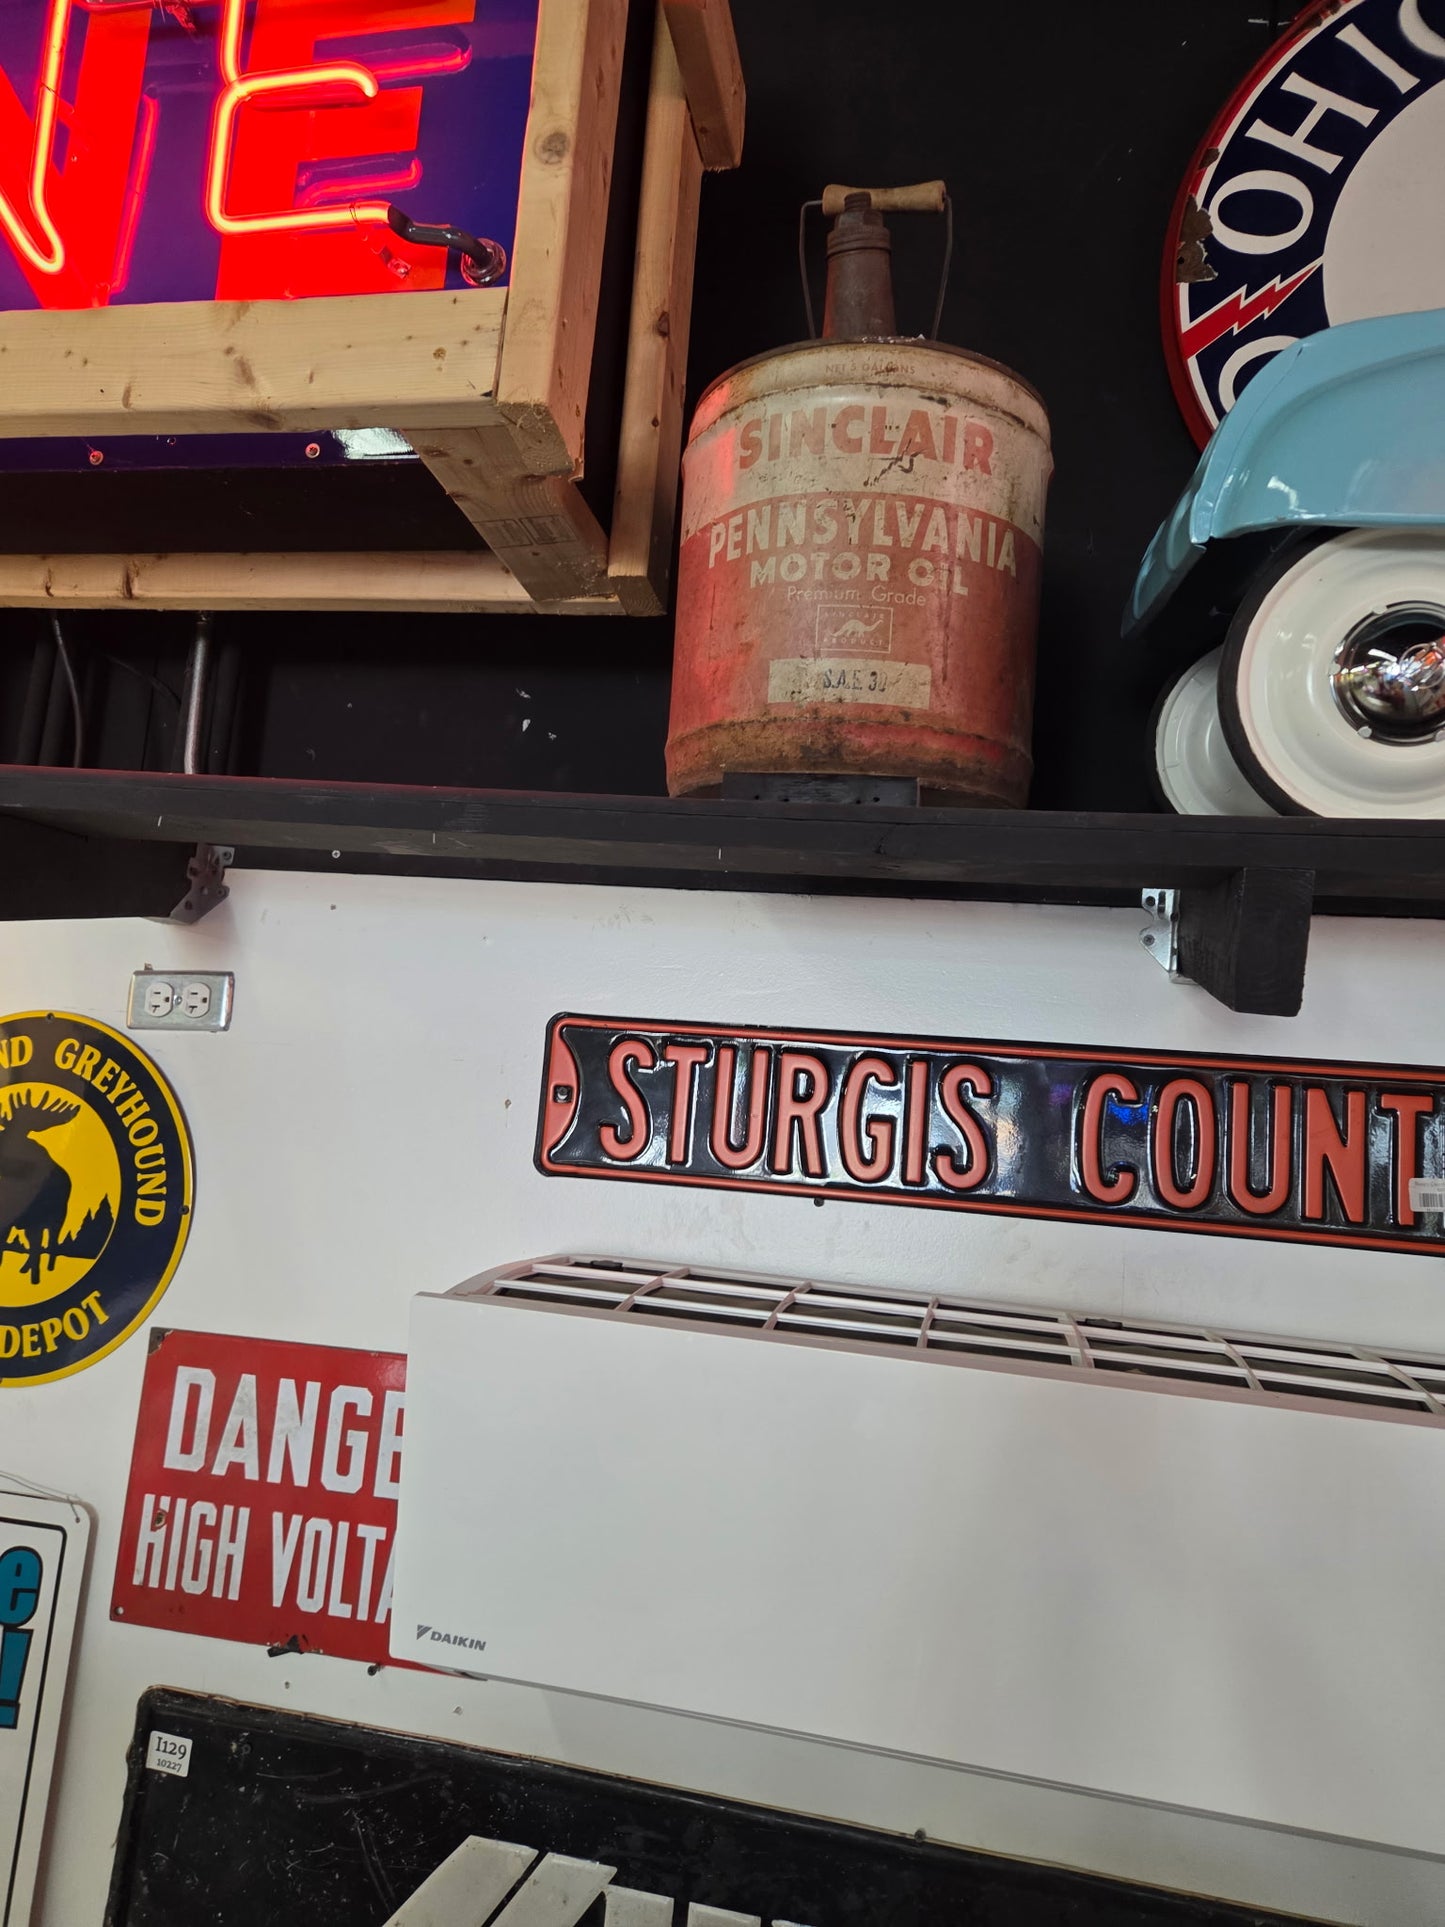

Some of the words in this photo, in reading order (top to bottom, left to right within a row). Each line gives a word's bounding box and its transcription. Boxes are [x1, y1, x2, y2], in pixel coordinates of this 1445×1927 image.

[739, 404, 994, 476] SINCLAIR
[708, 499, 1017, 578] PENNSYLVANIA
[750, 551, 891, 589] MOTOR
[907, 557, 969, 596] OIL
[787, 585, 861, 601] Premium
[871, 585, 927, 606] Grade
[55, 1038, 167, 1227] GREYHOUND
[599, 1039, 992, 1191] STURGIS
[0, 1290, 110, 1359] DEPOT
[132, 1493, 251, 1601] HIGH
[430, 1631, 487, 1651] DAIKIN
[156, 1758, 182, 1773] 10227
